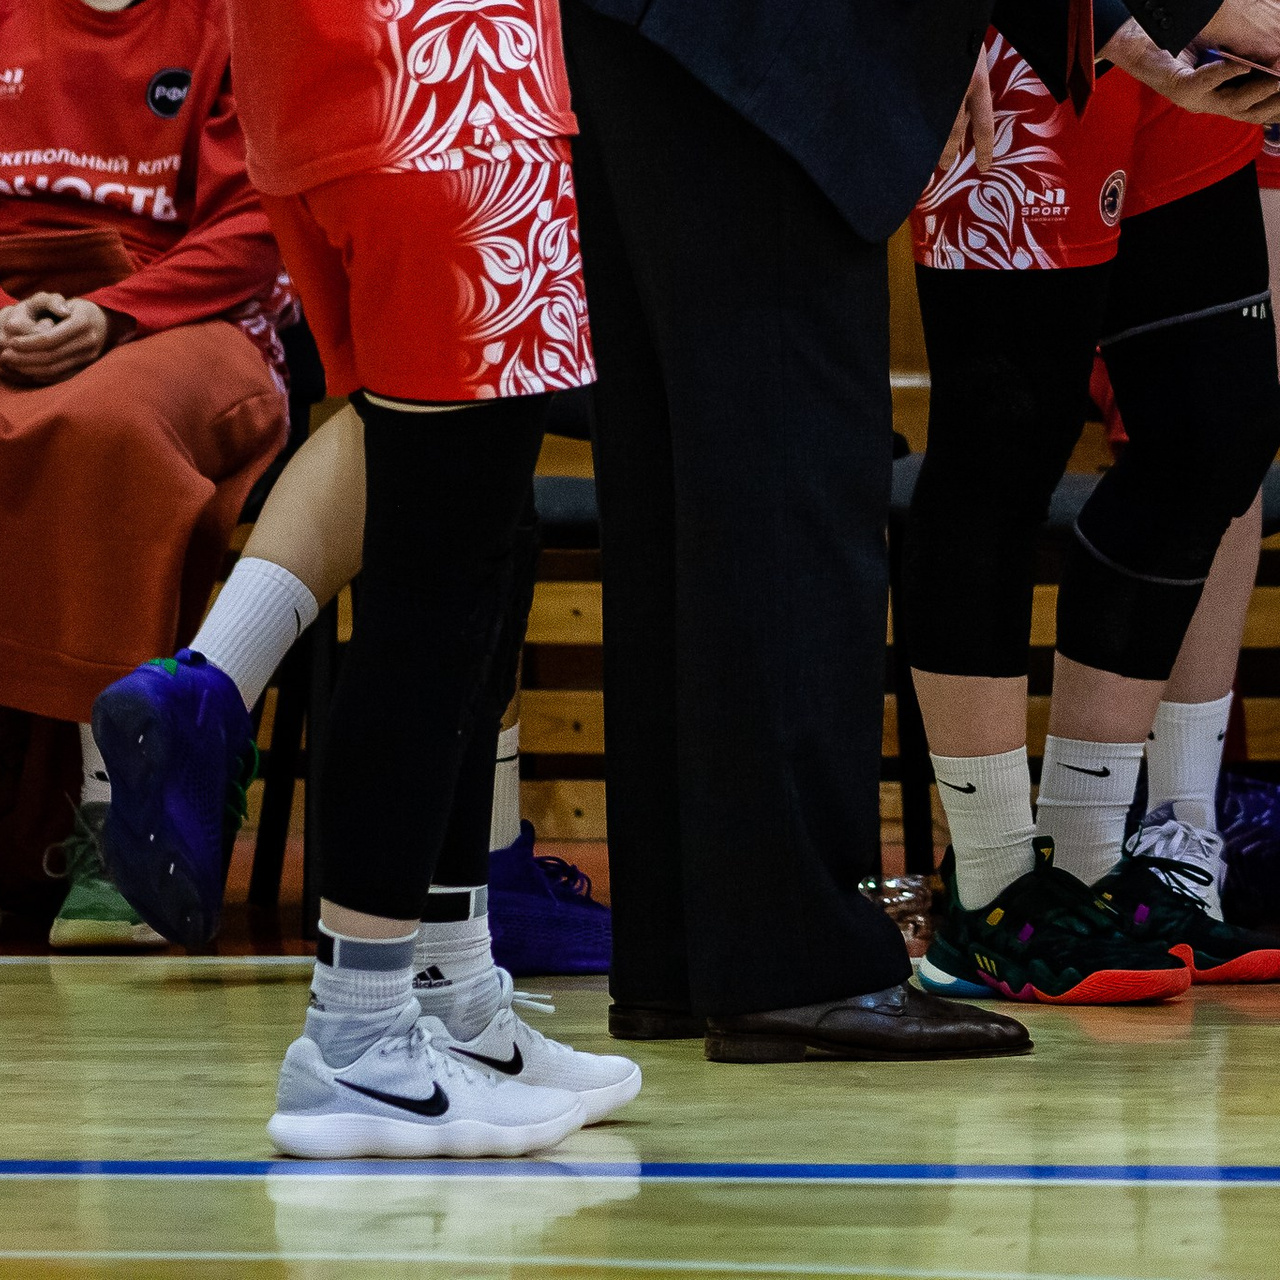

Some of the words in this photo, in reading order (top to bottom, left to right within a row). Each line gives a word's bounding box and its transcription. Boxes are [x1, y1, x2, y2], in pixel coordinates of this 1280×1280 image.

[0, 148, 129, 175] КЕТБОЛЬНЫЙ
[1021, 206, 1070, 216] SPORT
[412, 978, 453, 989] didas
